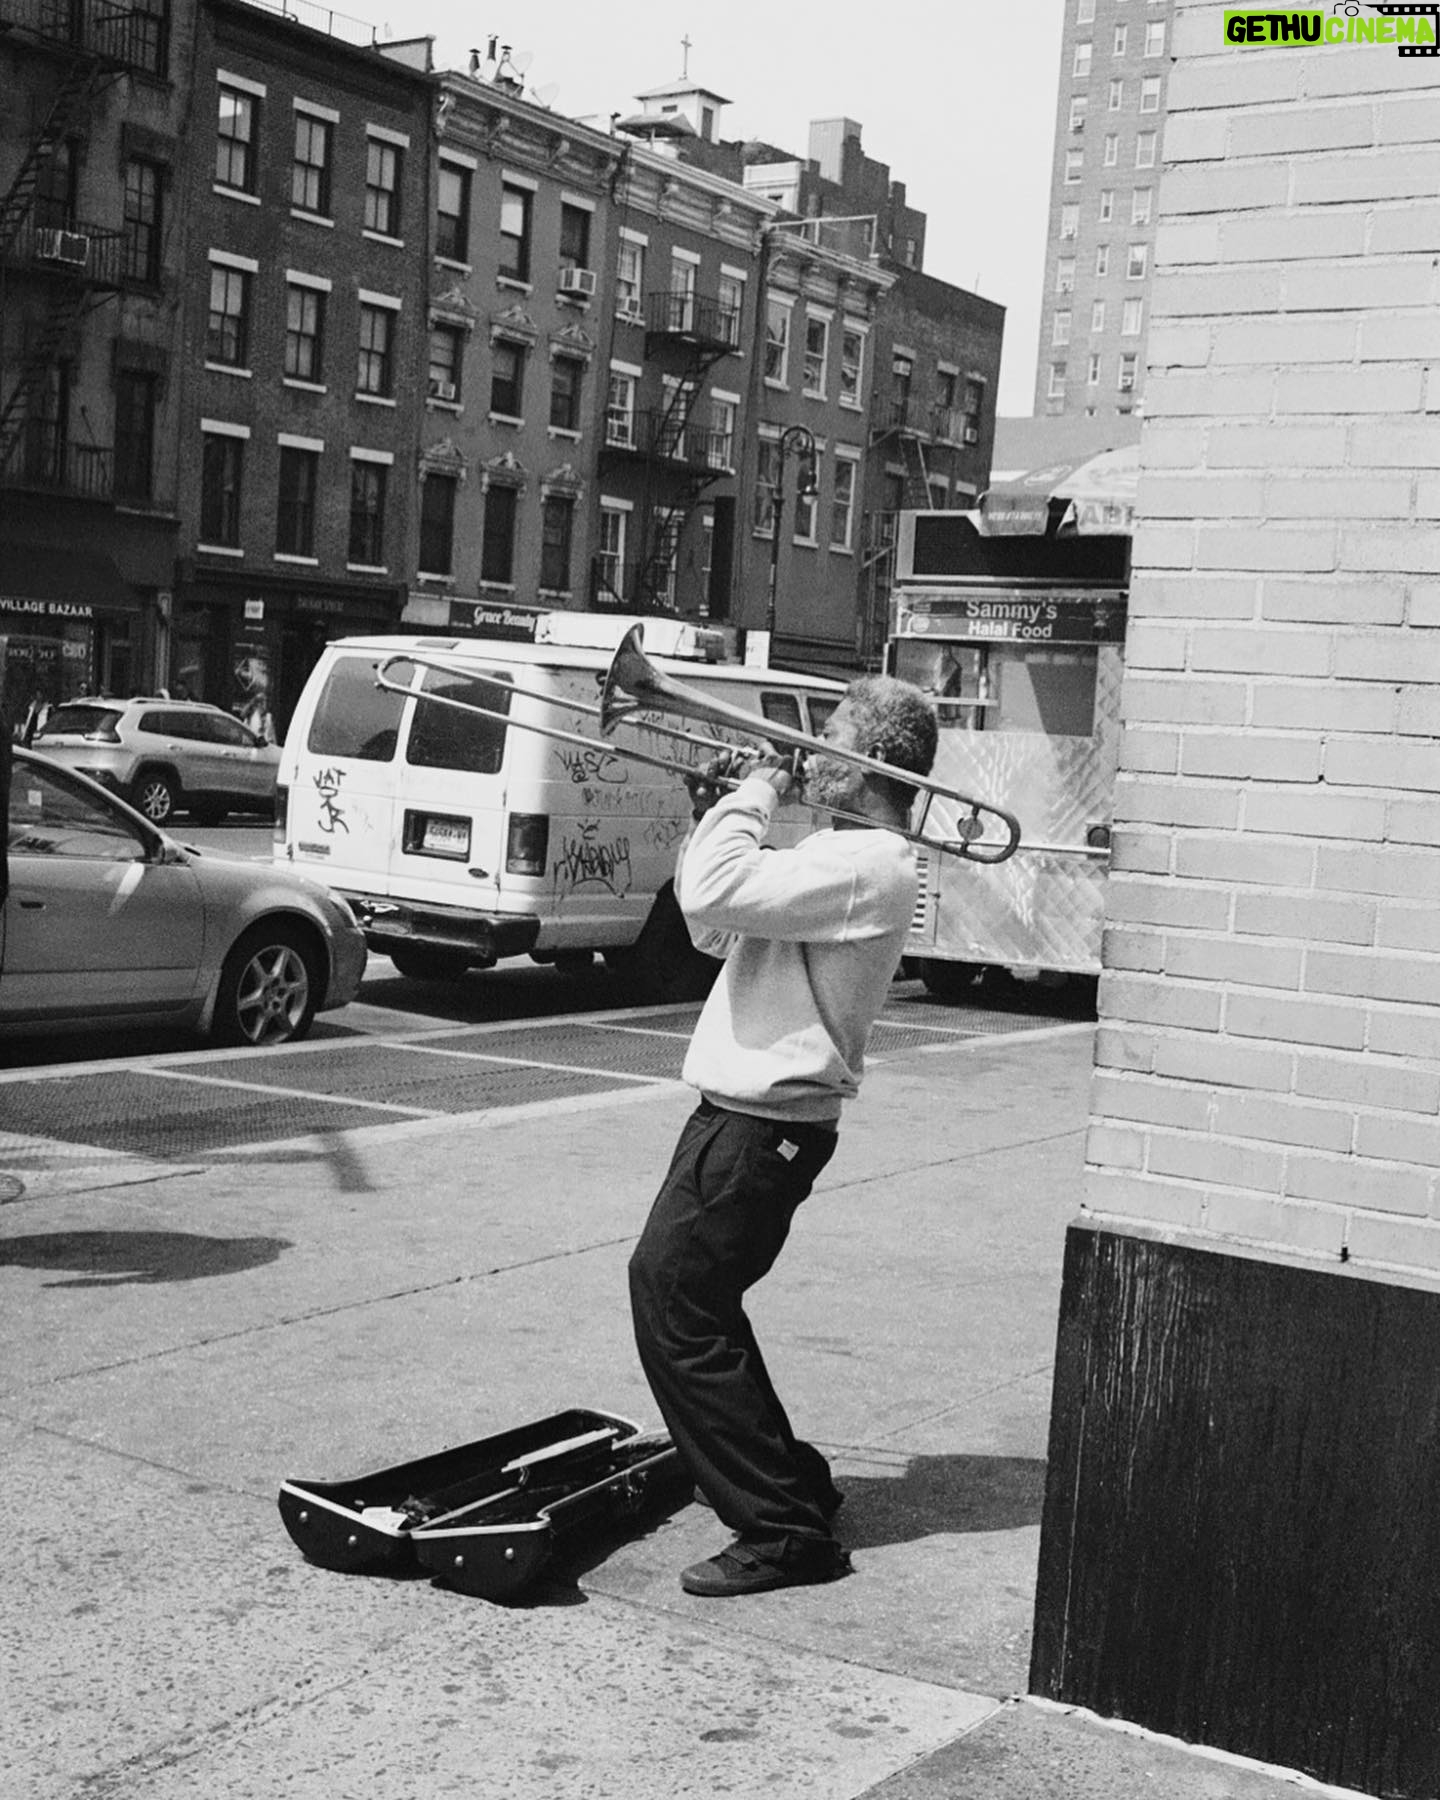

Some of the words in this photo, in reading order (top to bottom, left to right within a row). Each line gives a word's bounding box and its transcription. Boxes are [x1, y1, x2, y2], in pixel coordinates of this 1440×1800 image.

[0, 600, 46, 614] VILLAGE
[48, 603, 93, 618] BAZAAR
[473, 606, 501, 626] Grace
[502, 609, 536, 632] Beauty
[965, 600, 1058, 623] Sammy's
[967, 620, 1009, 637] Halal
[1011, 622, 1053, 638] Food
